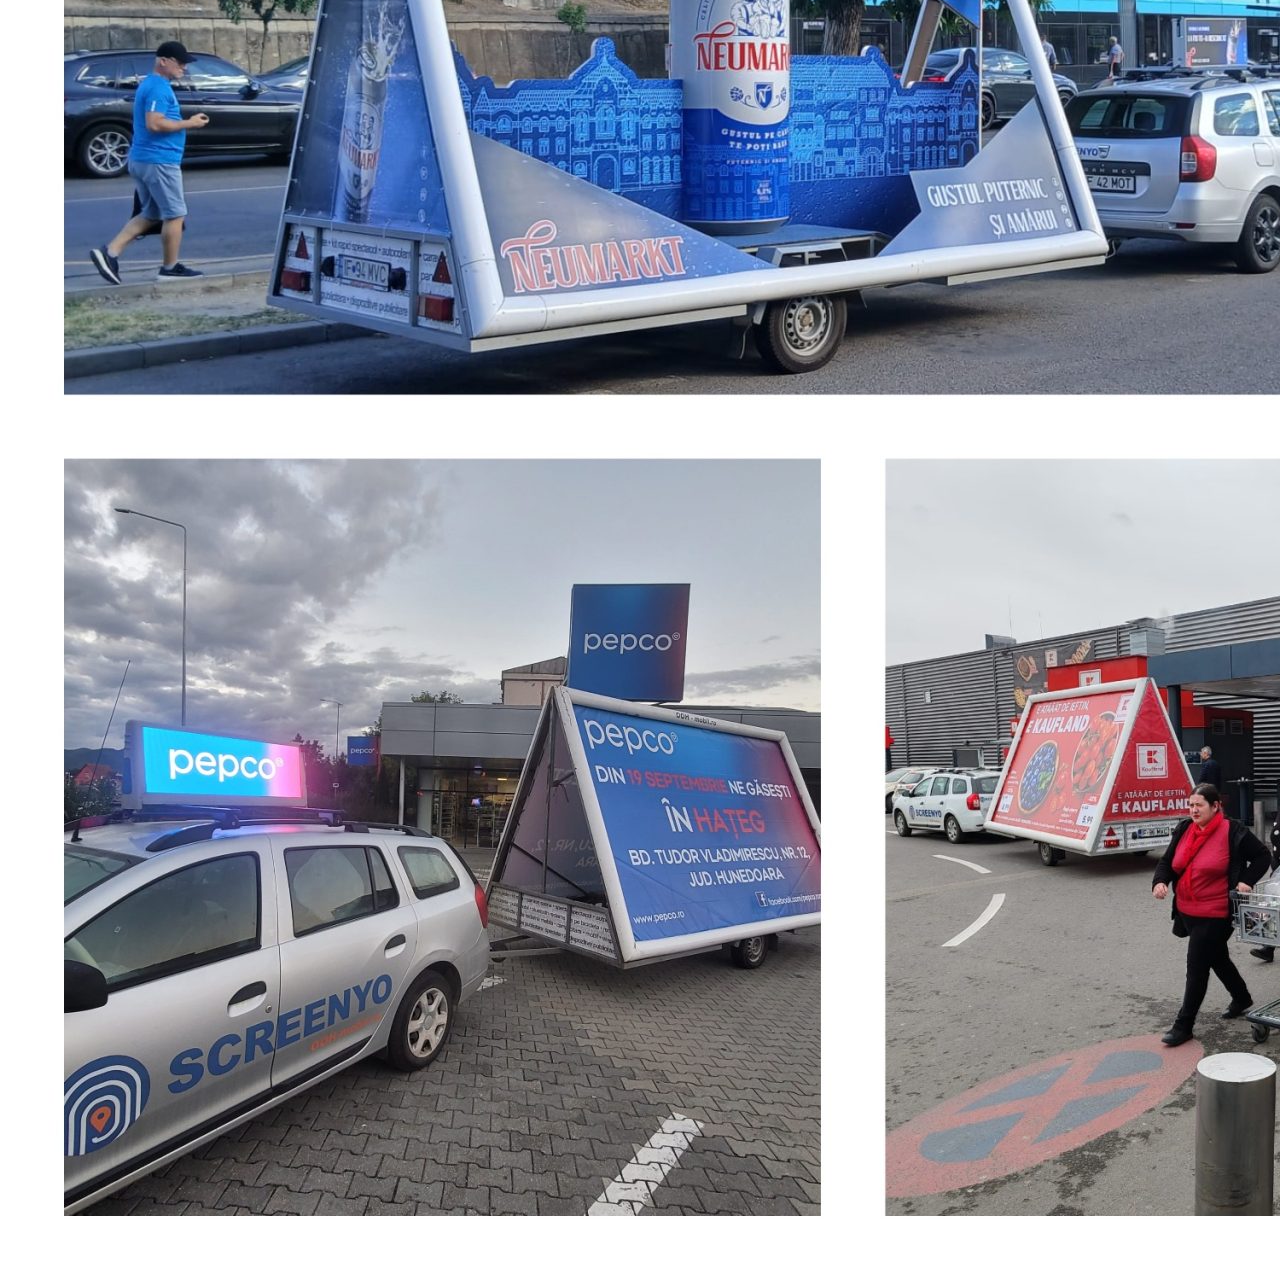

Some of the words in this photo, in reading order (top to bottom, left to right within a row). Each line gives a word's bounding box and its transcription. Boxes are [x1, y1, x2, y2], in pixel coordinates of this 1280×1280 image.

[721, 128, 761, 139] GUSTUL
[765, 130, 775, 139] PE
[729, 141, 742, 150] TE
[927, 183, 984, 207] GUSTUL
[984, 178, 1048, 203] PUTERNIC
[1097, 177, 1108, 188] 42
[1111, 177, 1131, 189] MOT
[989, 214, 1005, 239] ȘI
[1008, 208, 1058, 235] AMĂRUI
[501, 220, 686, 293] NEUMARKT
[368, 263, 387, 284] MVC
[583, 632, 672, 655] pepco
[1026, 721, 1034, 733] E
[1032, 715, 1090, 733] KAUFLAND
[584, 719, 674, 755] pepco
[350, 747, 372, 755] pepco
[169, 748, 276, 782] pepco
[595, 765, 627, 785] DIN
[627, 770, 642, 785] 19
[645, 771, 729, 793] SEPTEMBRIE
[728, 780, 746, 796] NE
[746, 777, 792, 801] GĂSEȘTI
[915, 809, 942, 818] SCREENYO
[1112, 803, 1119, 813] E
[1122, 798, 1191, 813] KAUFLAND
[661, 797, 694, 833] ÎN
[694, 807, 766, 839] HAȚEG
[628, 849, 655, 866] BD.
[655, 849, 699, 865] TUDOR
[700, 847, 783, 864] VLADIMIRESCU,
[783, 847, 797, 860] NR.
[797, 846, 811, 861] 12,
[689, 871, 716, 888] JUD.
[716, 868, 784, 886] HUNEDOARA
[633, 910, 685, 925] www.pepco.ro
[167, 974, 393, 1094] SCREENYO
